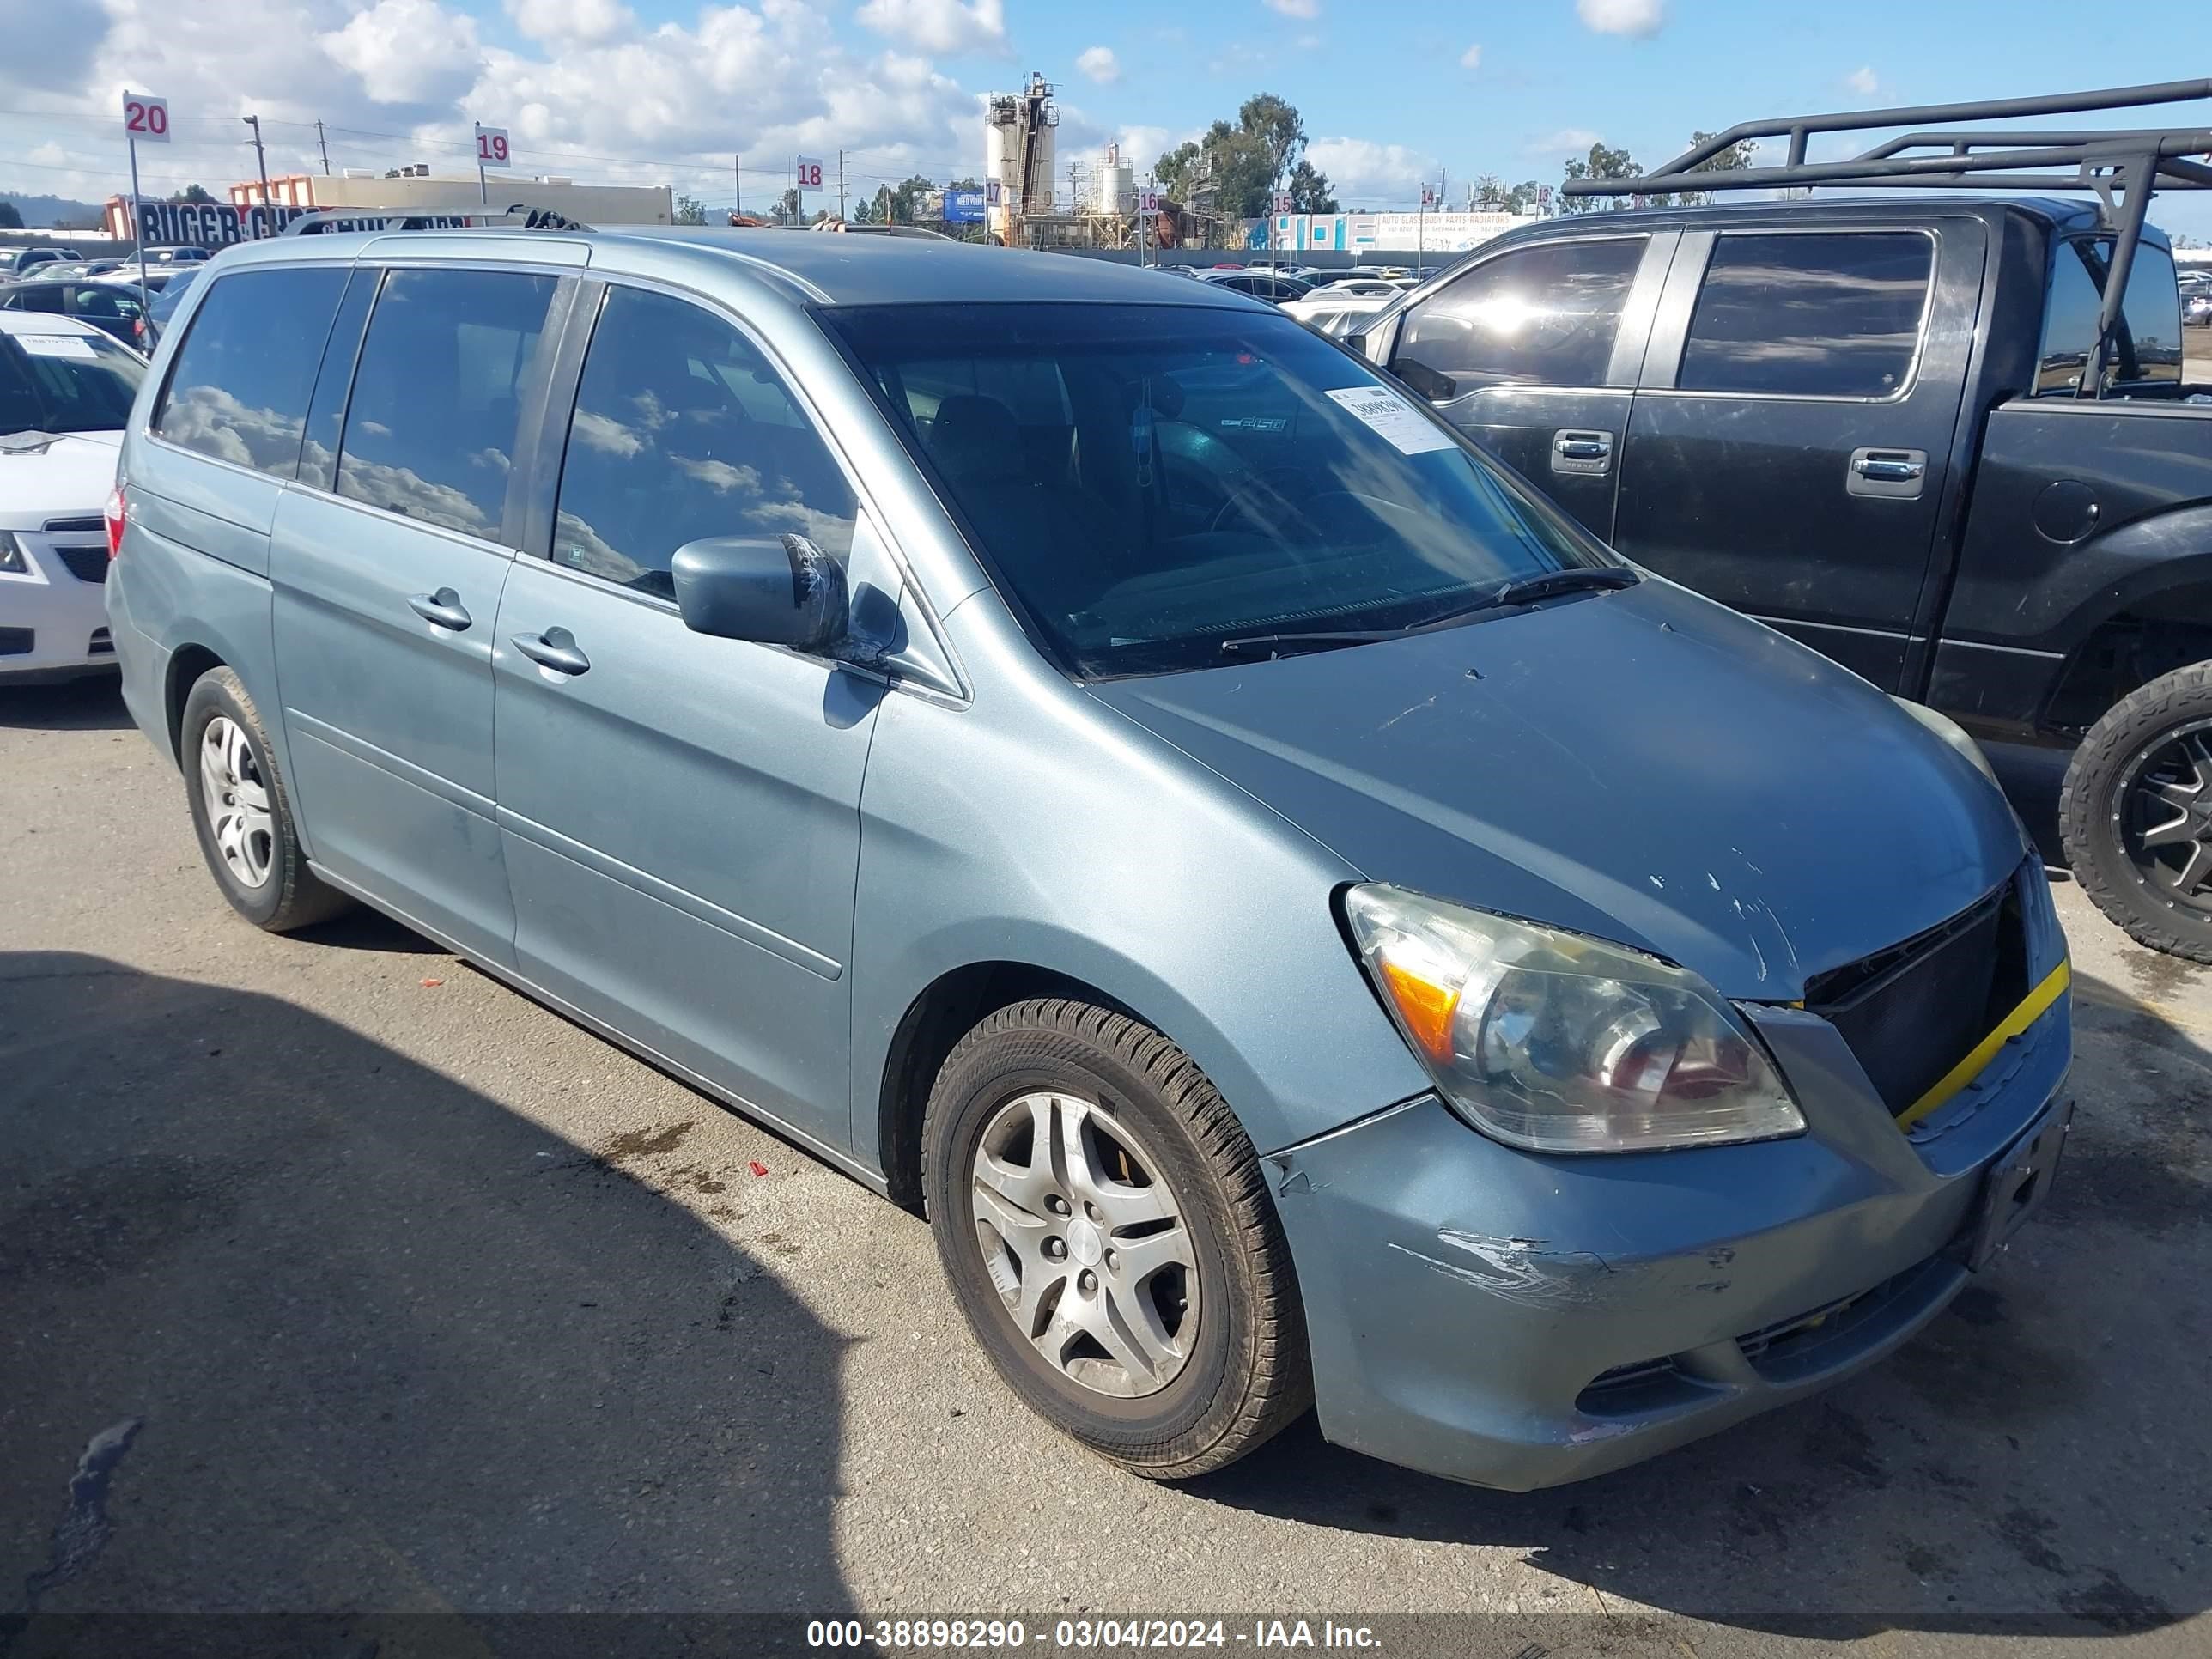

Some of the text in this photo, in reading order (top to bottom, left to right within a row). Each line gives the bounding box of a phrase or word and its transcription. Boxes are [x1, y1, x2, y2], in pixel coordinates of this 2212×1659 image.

[125, 101, 167, 134] 20
[477, 134, 508, 161] 19
[798, 164, 822, 186] 18
[986, 182, 1001, 203] 17
[1140, 192, 1157, 210] 16
[1421, 188, 1434, 204] 14
[1539, 188, 1549, 202] 13
[970, 197, 983, 206] YOUR
[1274, 196, 1291, 213] 15
[1382, 216, 1400, 225] AUTO
[1401, 216, 1421, 225] GLASS
[1425, 216, 1443, 225] BODY
